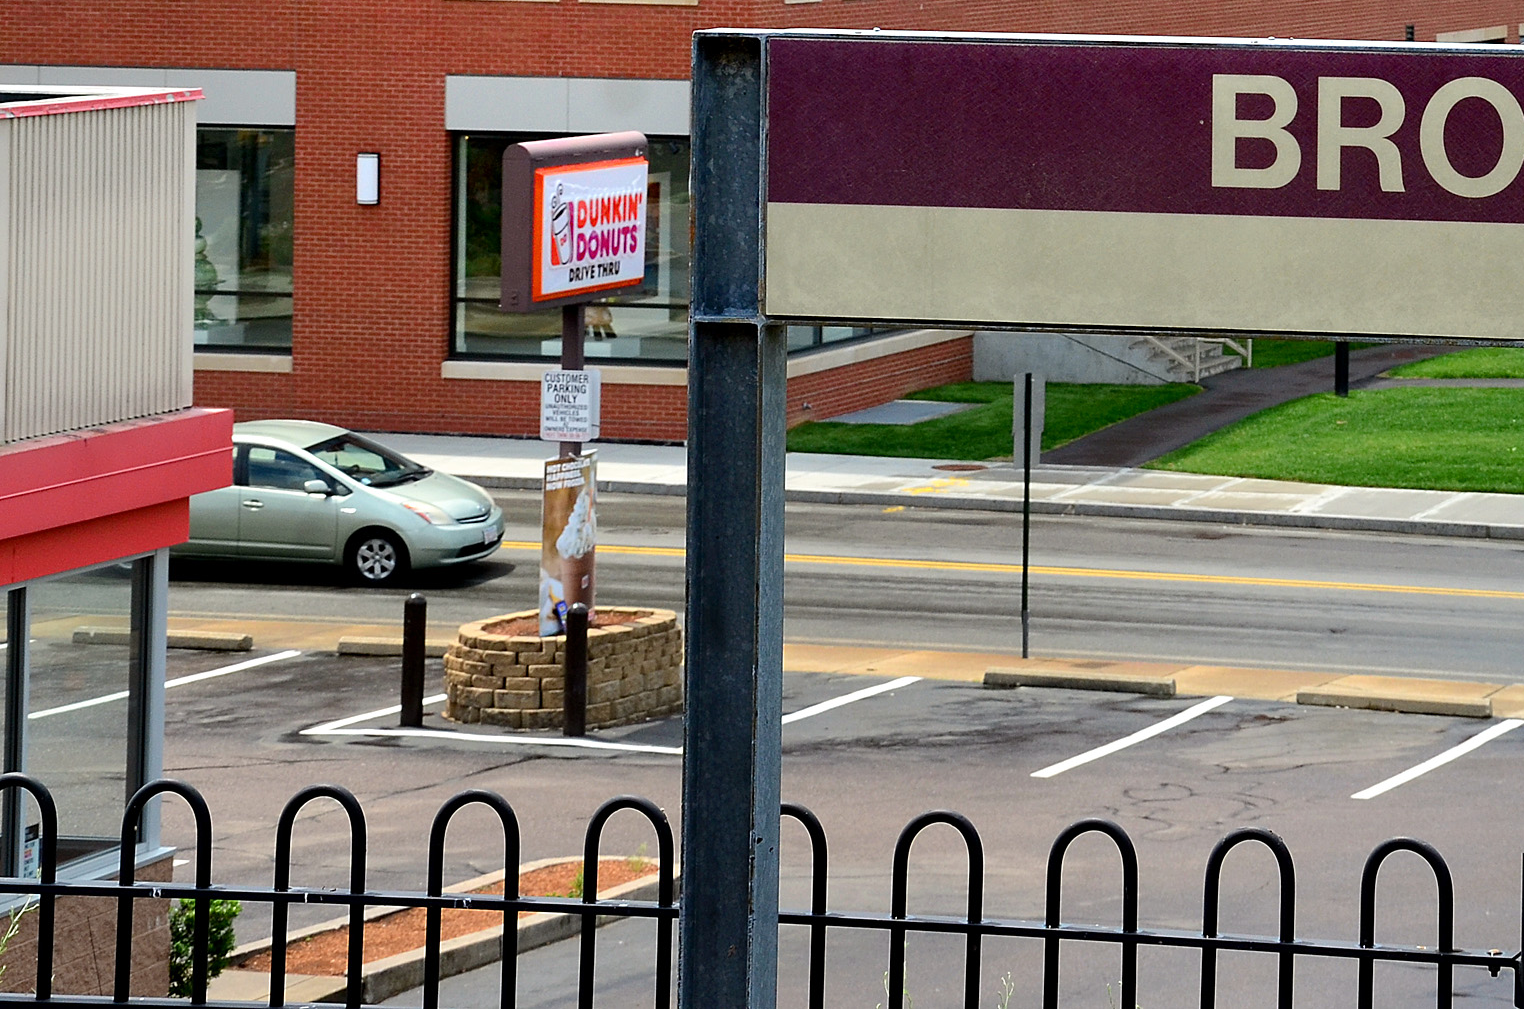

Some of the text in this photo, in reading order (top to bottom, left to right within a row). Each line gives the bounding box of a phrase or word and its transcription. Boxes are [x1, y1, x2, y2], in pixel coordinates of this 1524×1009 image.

[577, 192, 642, 228] DUNKIN'
[576, 224, 637, 261] DONUTS
[569, 261, 620, 282] DRIVE THRU
[545, 373, 589, 384] CUSTOMER
[547, 383, 587, 394] PARKING
[554, 393, 577, 403] ONLY
